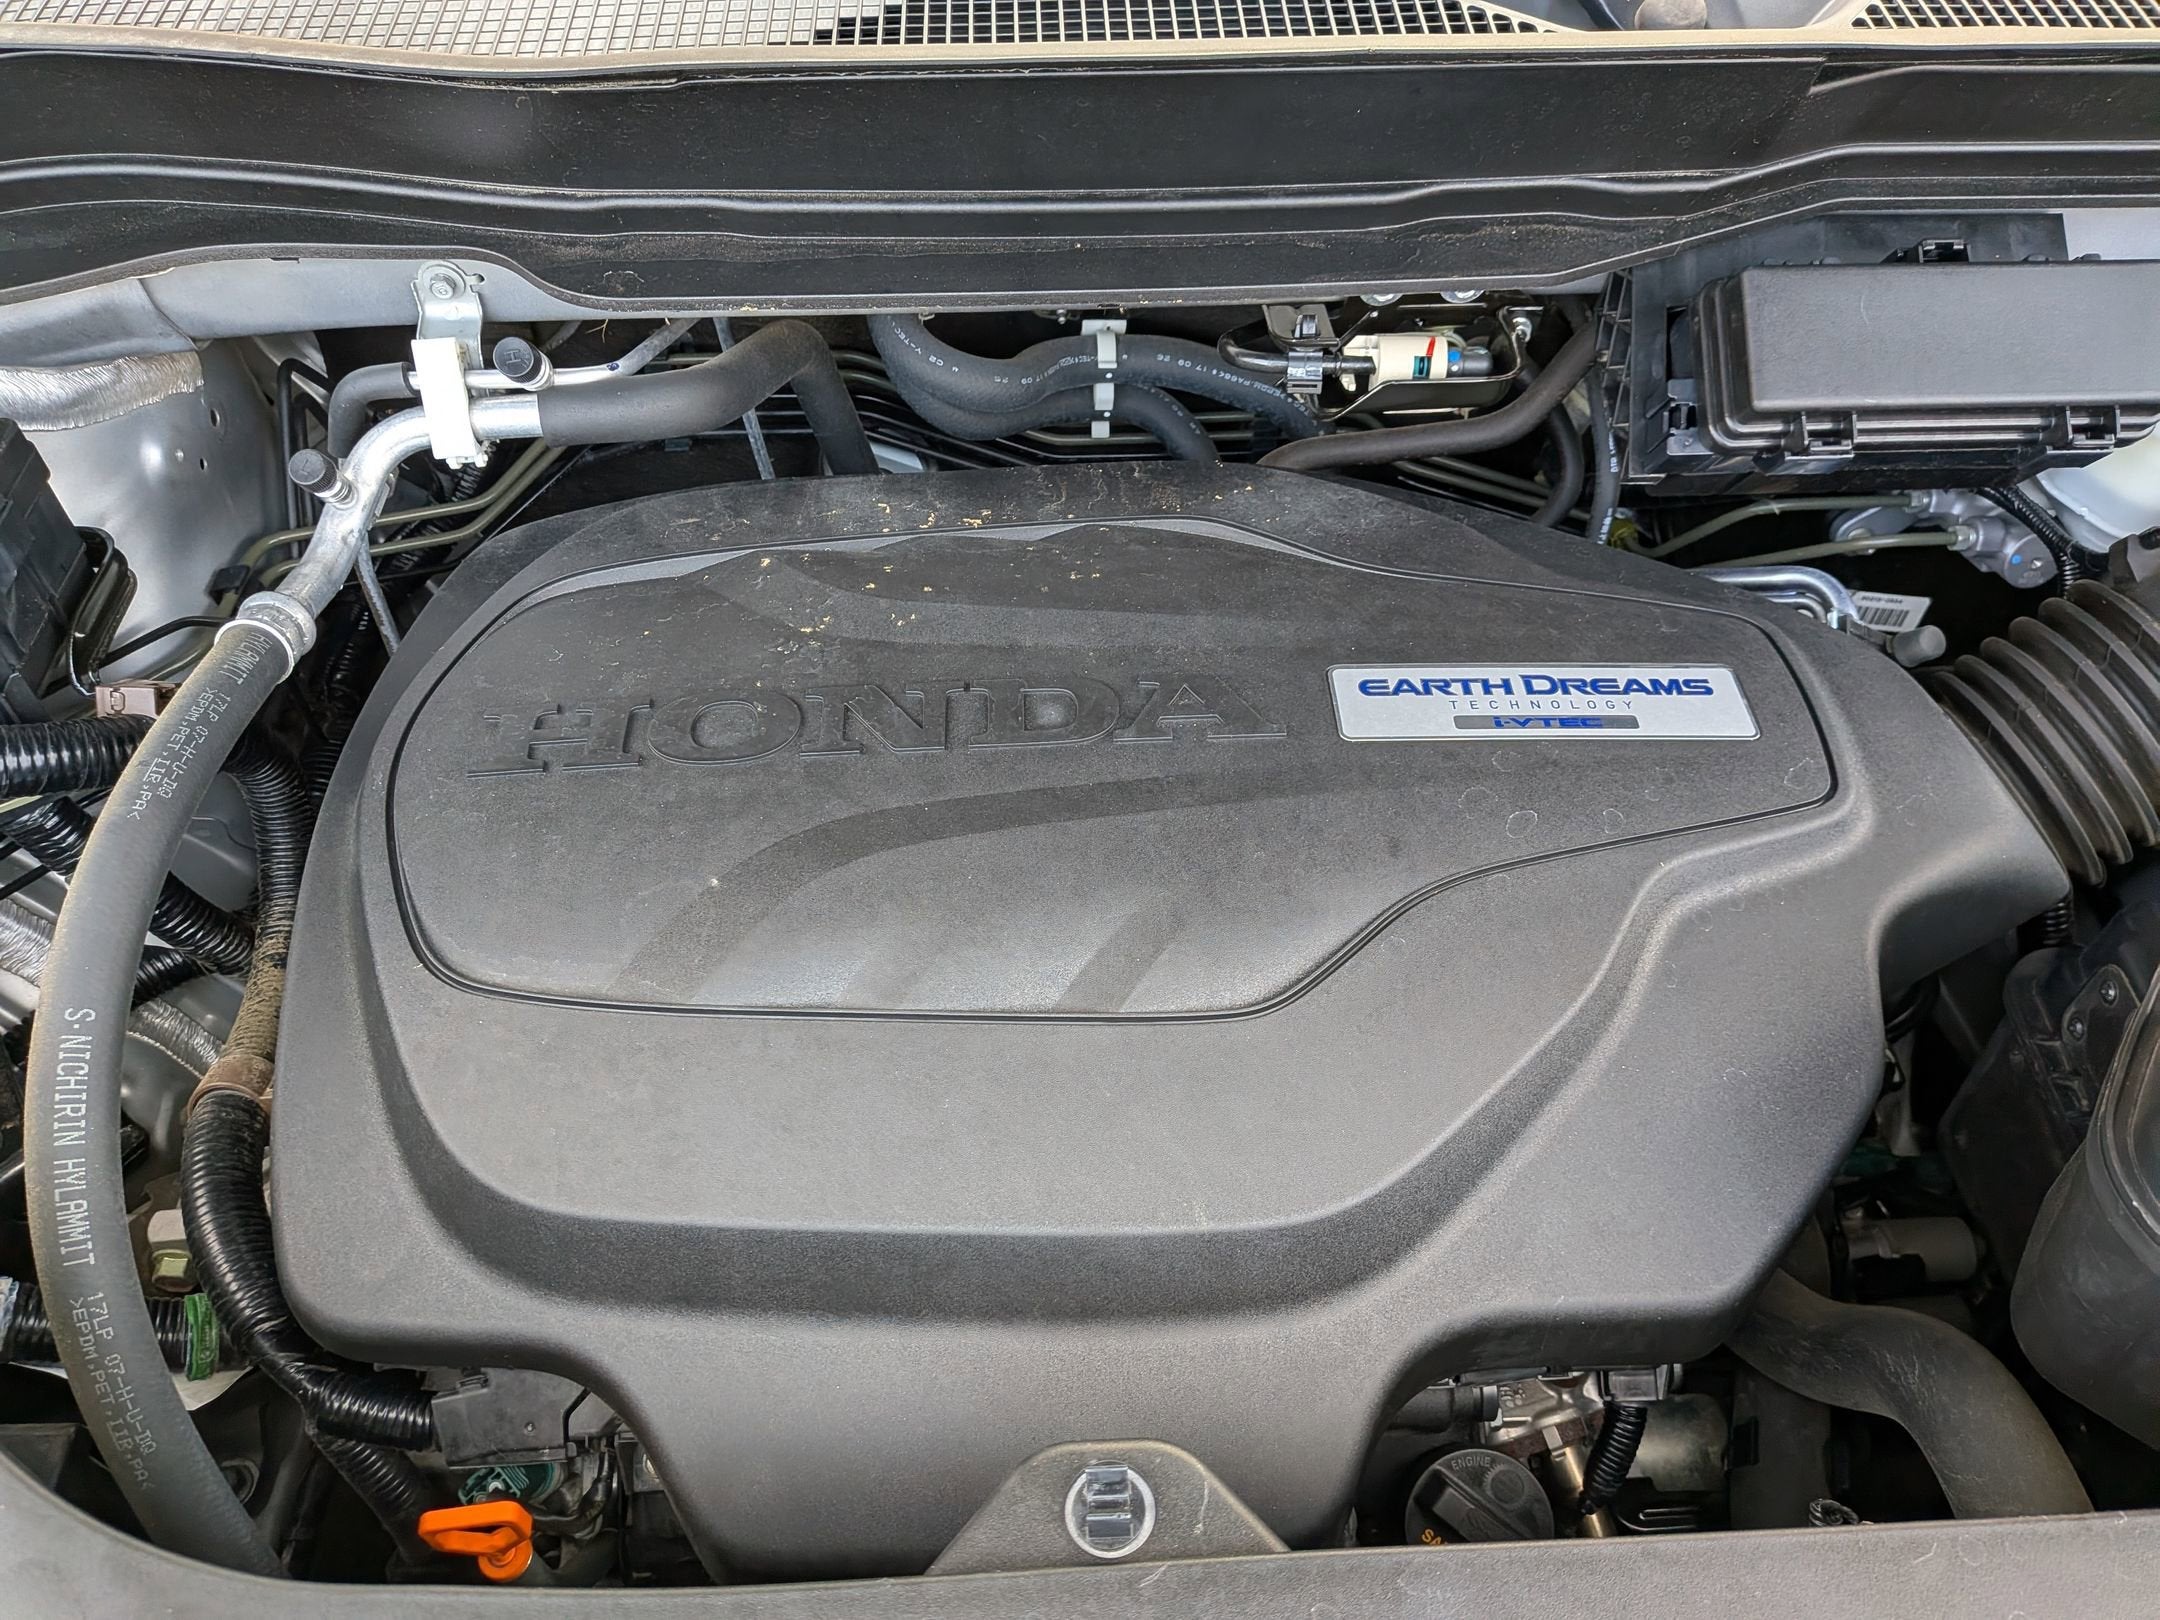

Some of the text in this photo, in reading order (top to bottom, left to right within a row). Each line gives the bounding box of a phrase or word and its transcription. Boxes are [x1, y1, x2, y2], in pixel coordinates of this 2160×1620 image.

[1357, 673, 1715, 698] EARTH DREAMS
[1449, 699, 1635, 711] TECHNOLOGY
[466, 673, 1288, 779] HONDA
[53, 1158, 96, 1267] HYLAMMIT
[1451, 1456, 1492, 1471] ENGINE
